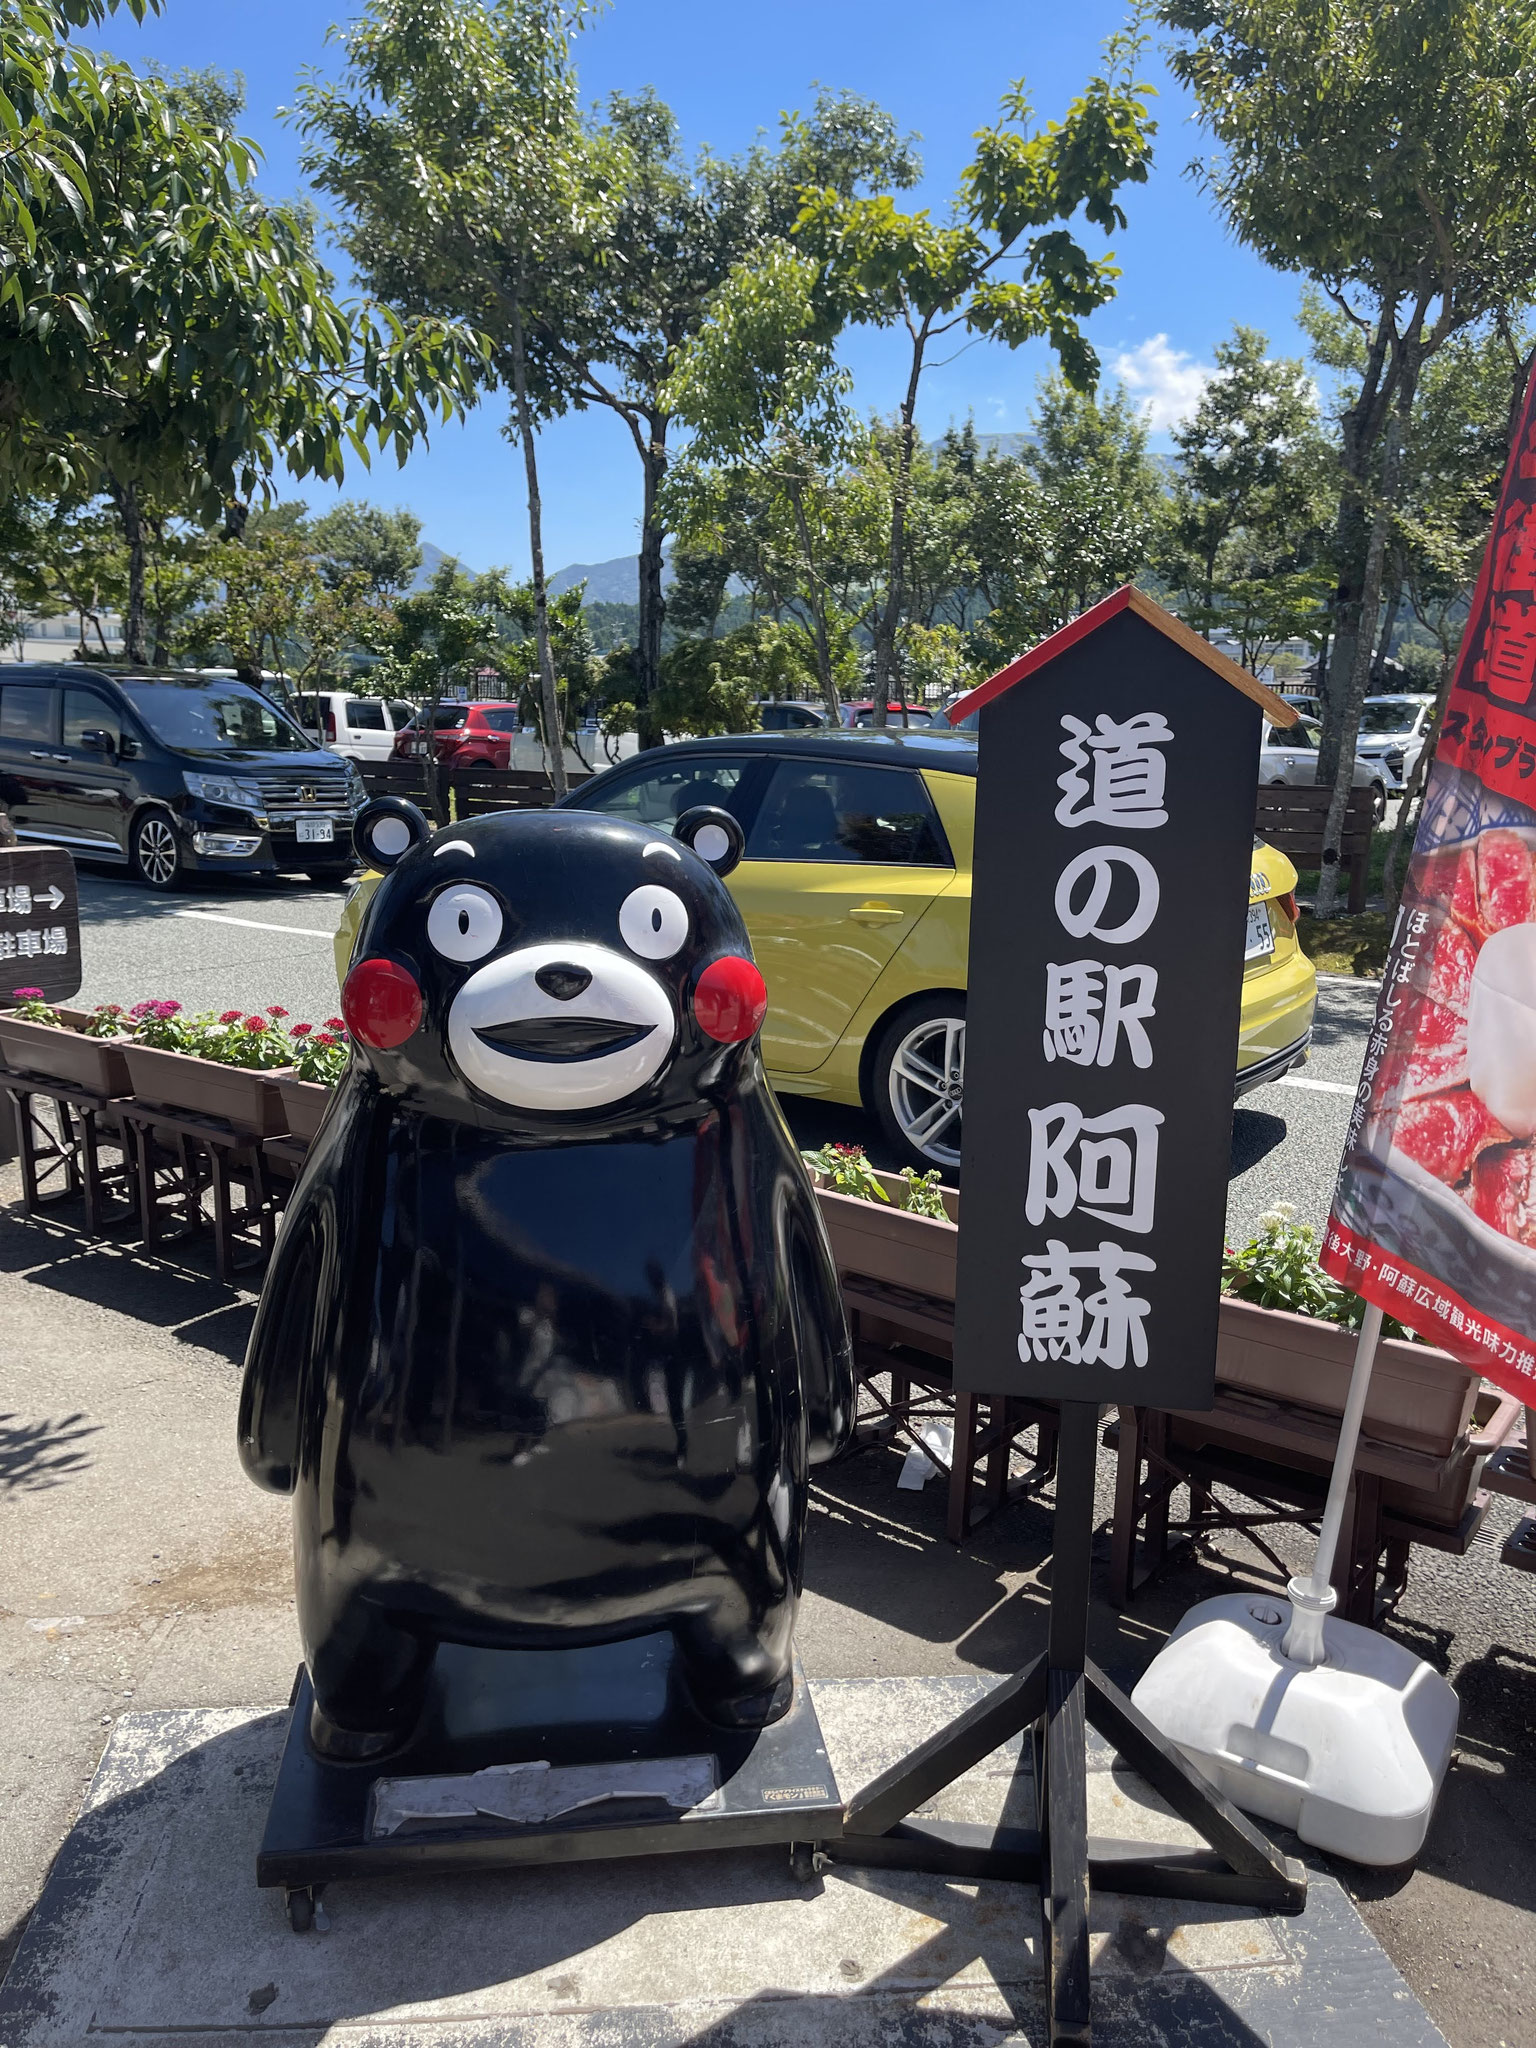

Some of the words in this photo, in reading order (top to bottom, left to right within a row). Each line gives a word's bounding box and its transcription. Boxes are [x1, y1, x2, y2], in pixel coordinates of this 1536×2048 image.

[305, 828, 332, 840] 31-94
[0, 884, 33, 915] 場
[1323, 1224, 1536, 1382] 後大野・阿蘇広域観光味力推
